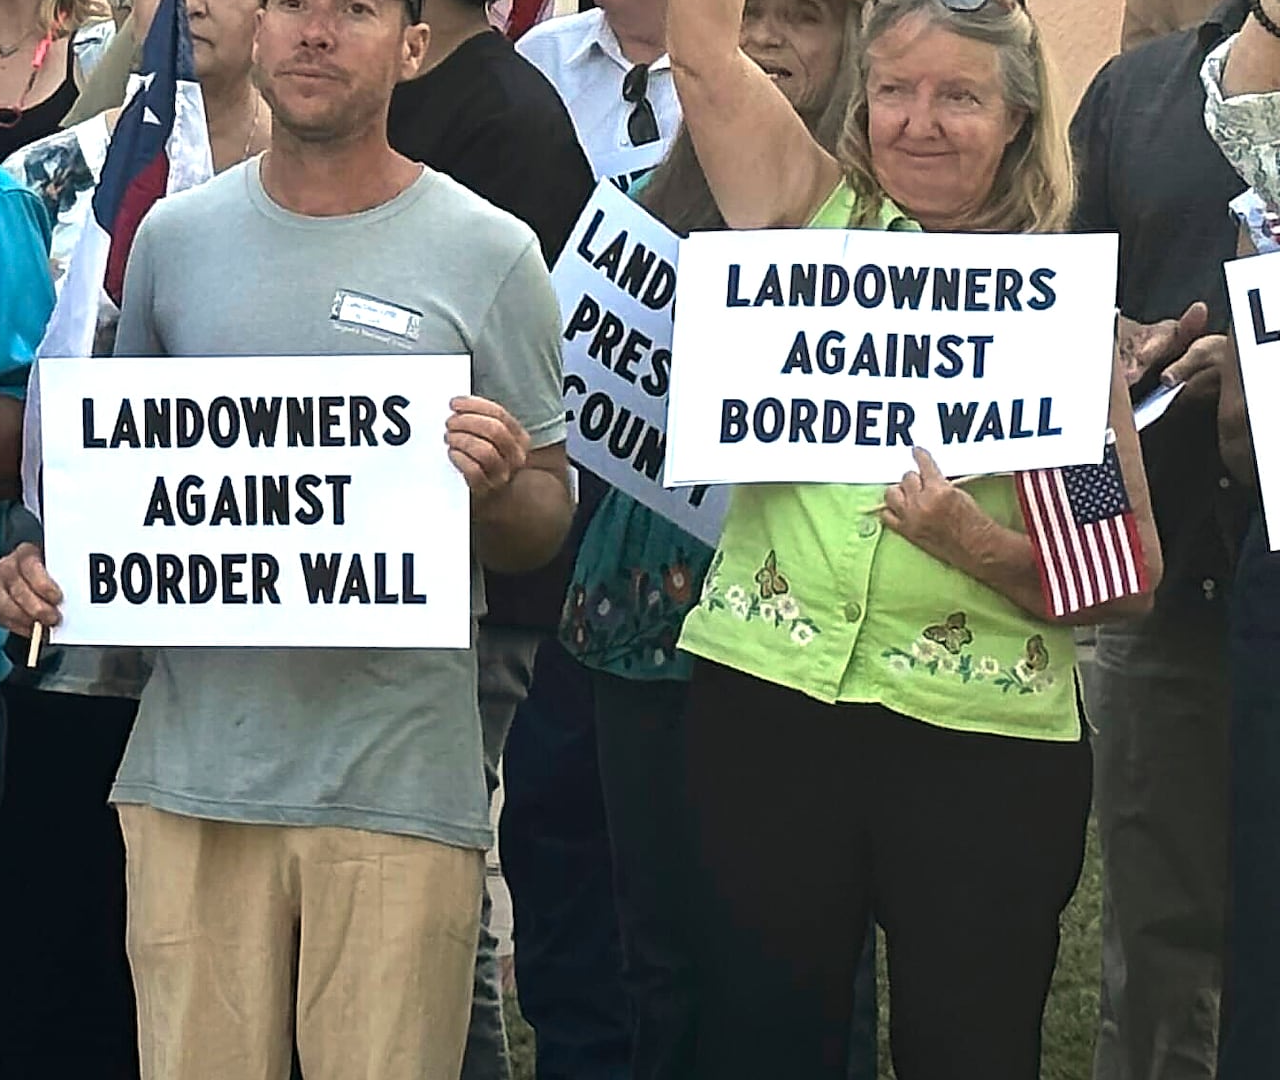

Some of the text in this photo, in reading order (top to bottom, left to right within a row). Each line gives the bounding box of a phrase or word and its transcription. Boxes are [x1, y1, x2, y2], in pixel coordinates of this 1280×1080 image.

[726, 263, 1058, 312] LANDOWNERS
[780, 330, 994, 379] AGAINST
[81, 395, 412, 449] LANDOWNERS
[719, 397, 1063, 447] BORDER WALL
[143, 474, 352, 527] AGAINST
[88, 552, 427, 605] BORDER WALL
